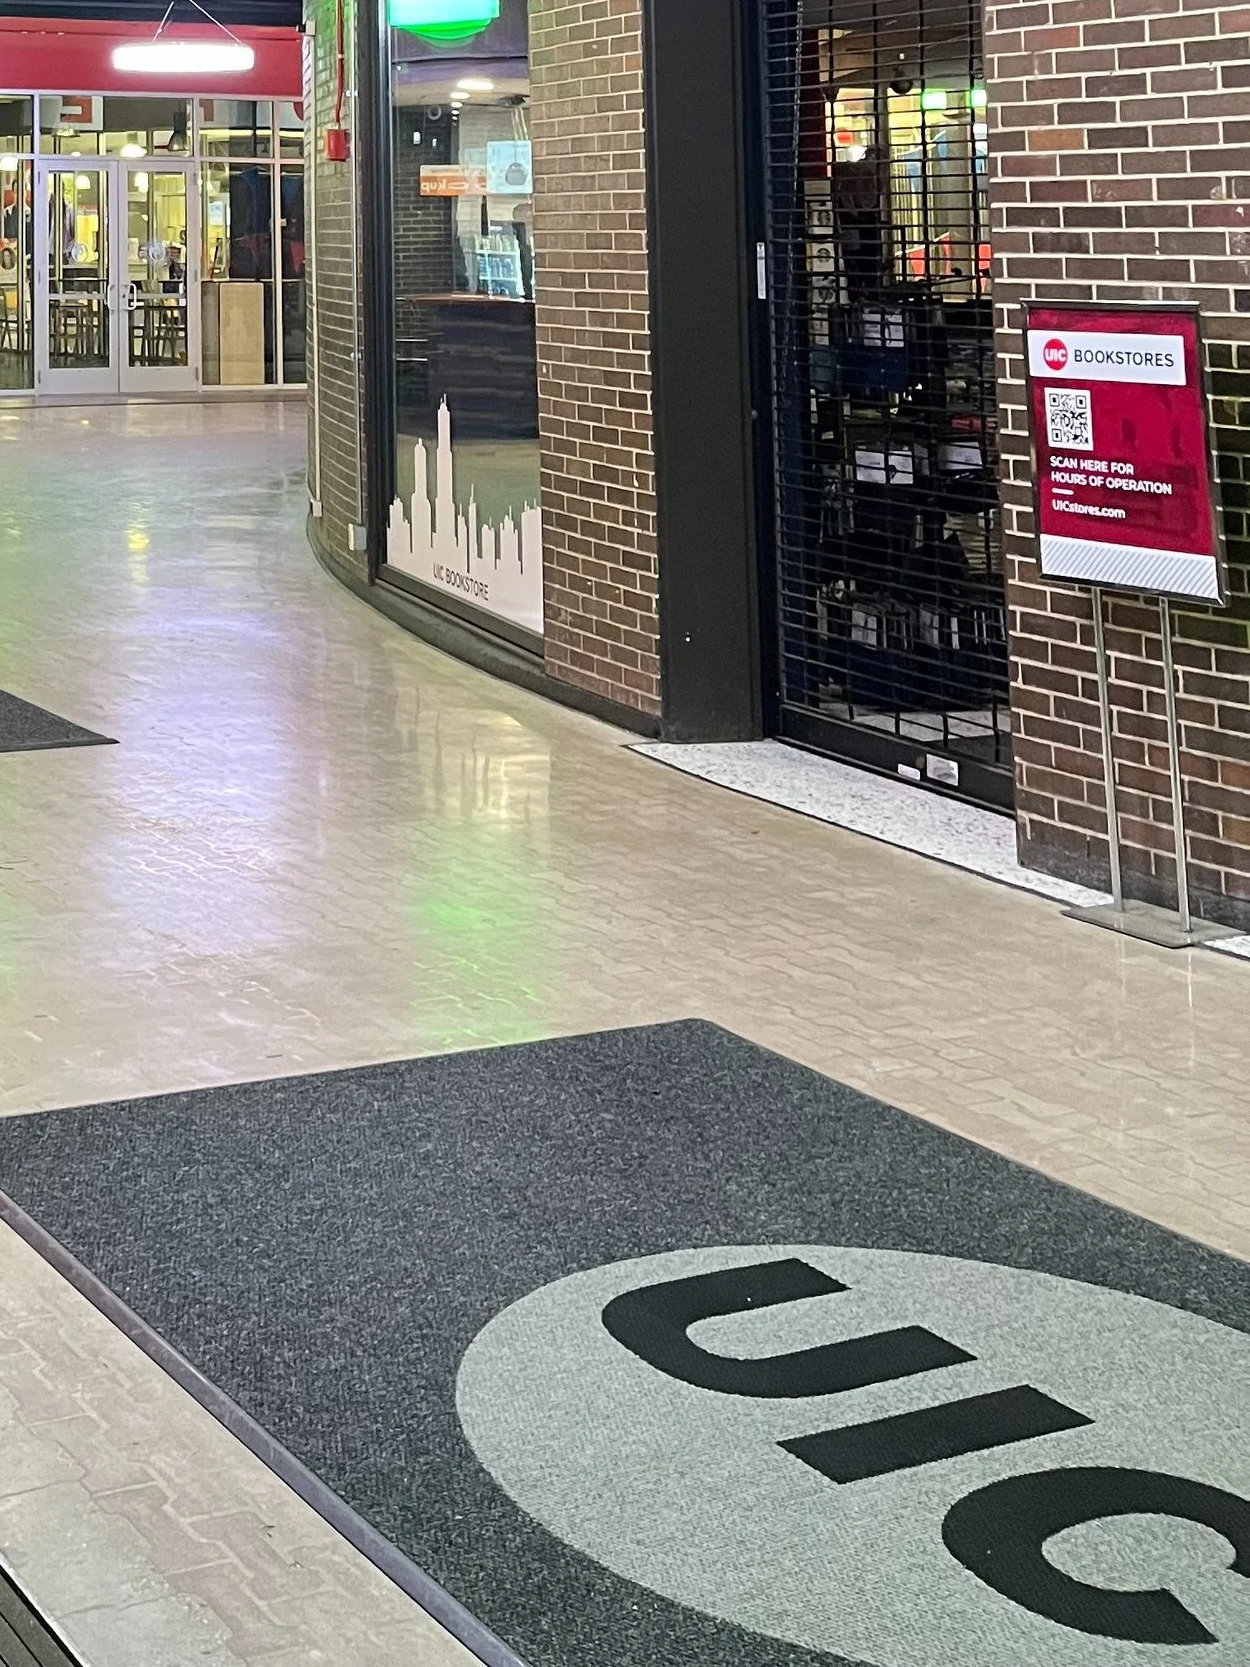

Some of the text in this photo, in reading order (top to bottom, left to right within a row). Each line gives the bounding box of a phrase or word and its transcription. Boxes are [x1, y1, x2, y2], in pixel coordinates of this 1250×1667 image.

[1044, 347, 1174, 367] UIC BOOKSTORES
[1050, 456, 1134, 476] SCAN HERE FOR
[1051, 471, 1172, 495] HOURS OF OPERATION
[1052, 499, 1126, 518] UICstores.com
[433, 563, 489, 601] UIC BOOKSTORE
[601, 1257, 1250, 1646] UIC
